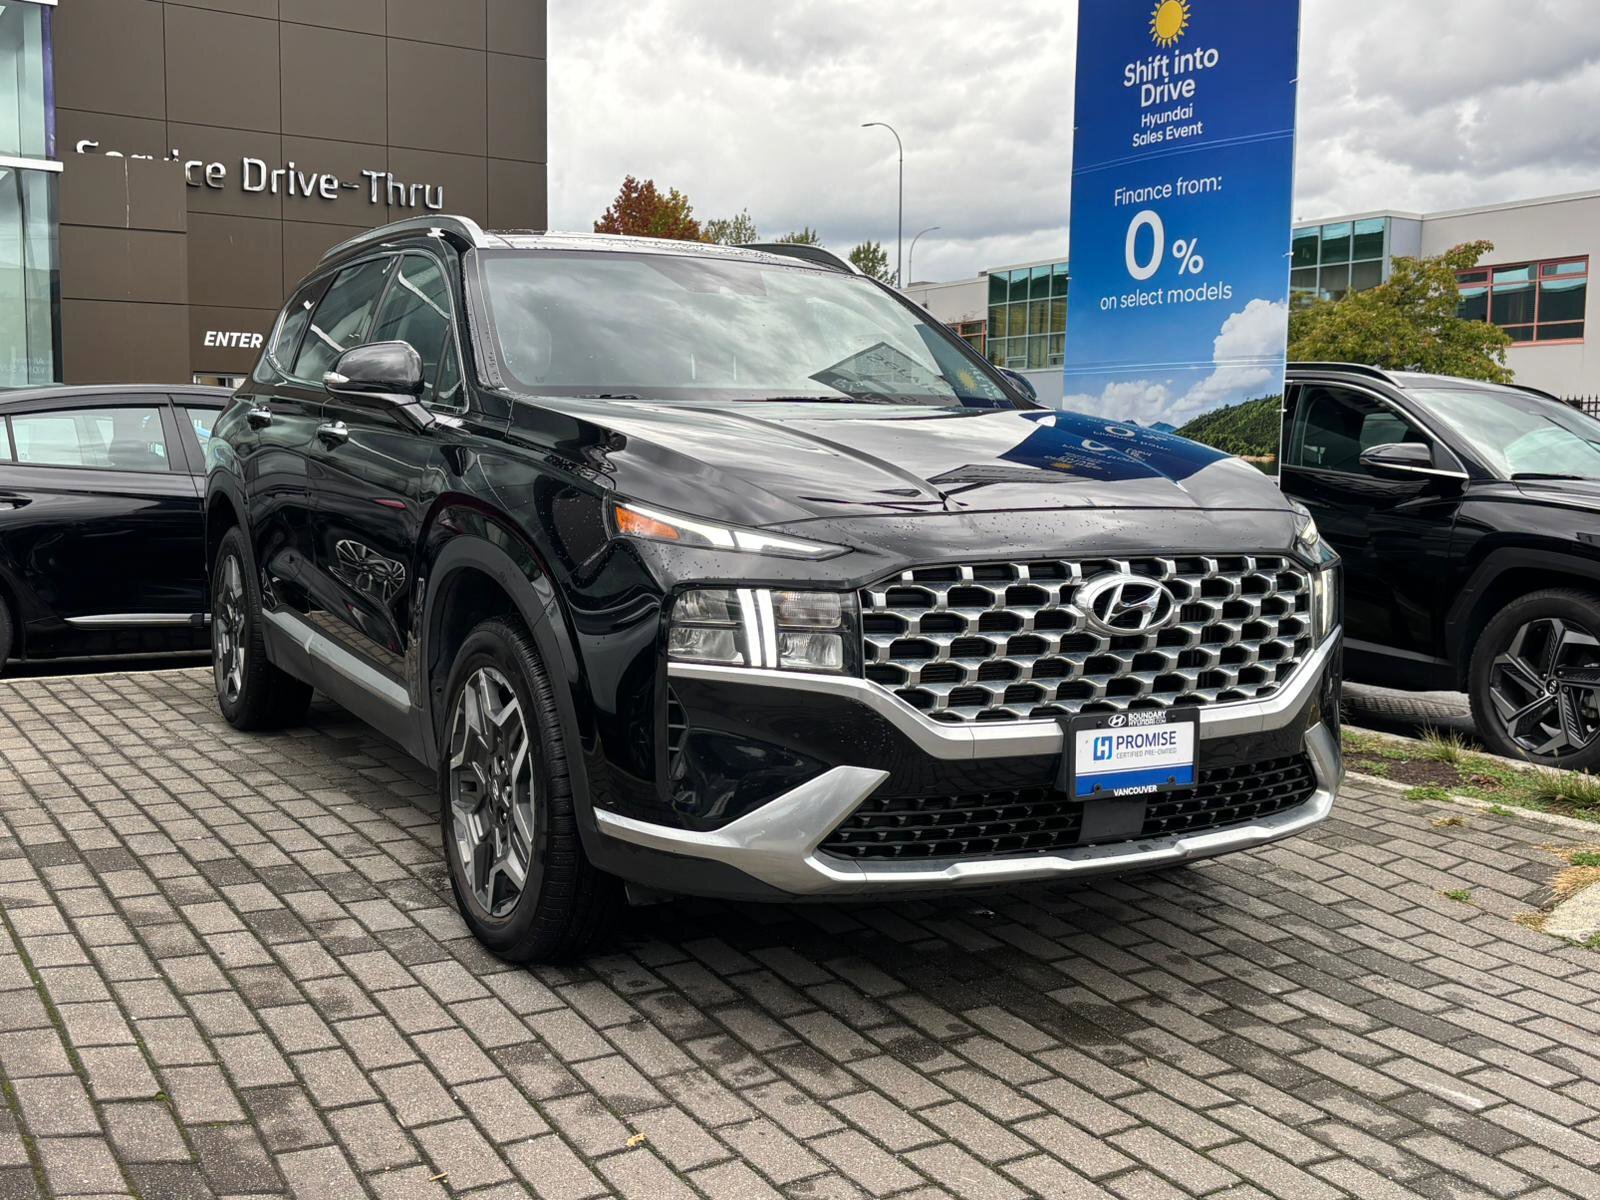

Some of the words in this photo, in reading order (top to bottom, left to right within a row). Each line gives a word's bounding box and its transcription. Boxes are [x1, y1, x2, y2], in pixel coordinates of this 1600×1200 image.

[1123, 55, 1169, 87] Shift
[1174, 47, 1219, 75] into
[1141, 78, 1196, 107] Drive
[1141, 103, 1193, 129] Hyundai
[1132, 130, 1163, 147] Sales
[1166, 121, 1203, 140] Event
[243, 156, 443, 210] Drive-Thru
[1114, 183, 1172, 207] Finance
[1177, 175, 1223, 196] from:
[1100, 295, 1117, 311] on
[1120, 288, 1163, 308] select
[1167, 281, 1233, 304] models
[204, 331, 263, 348] ENTER
[1129, 711, 1167, 720] BOUNDARY
[1116, 731, 1177, 750] PROMISE
[1116, 750, 1143, 759] CERTIFIED
[1114, 785, 1157, 796] VANCOUVER
